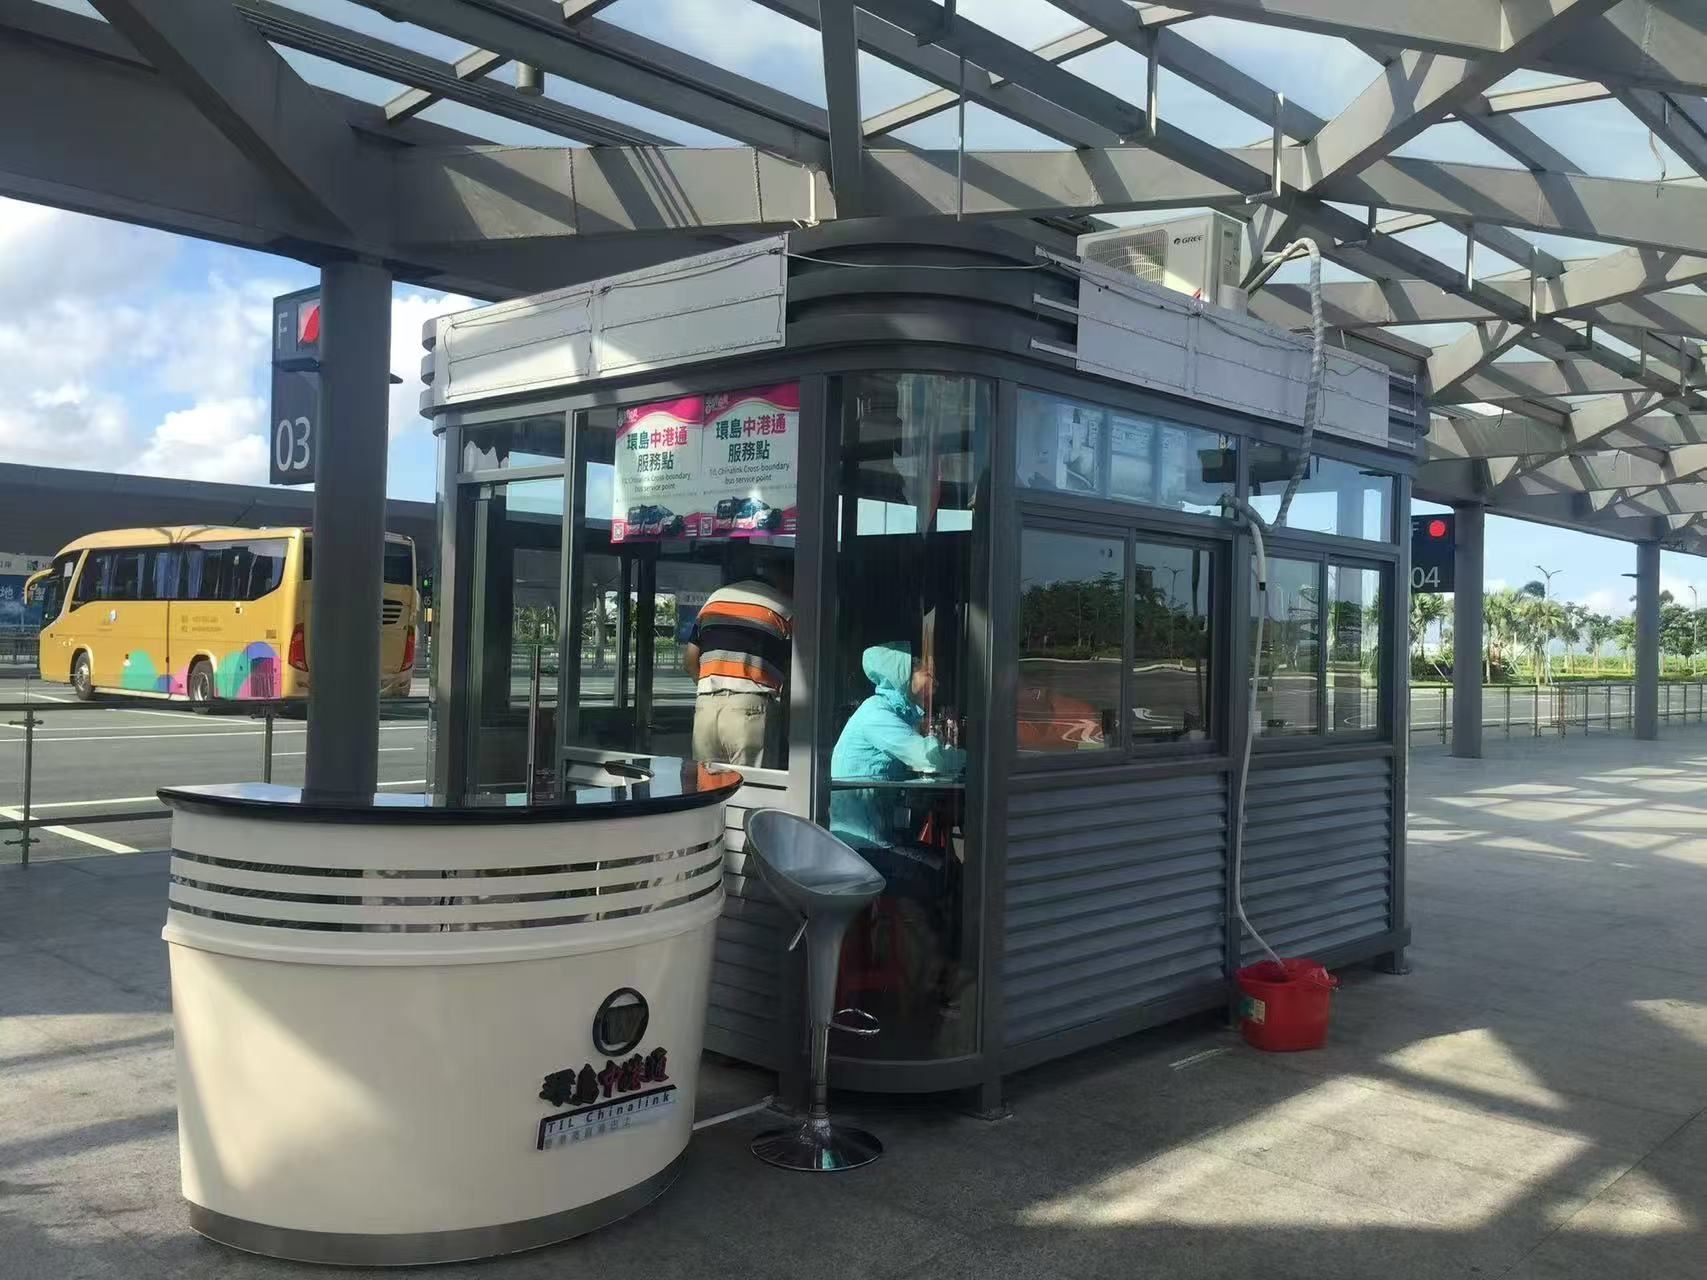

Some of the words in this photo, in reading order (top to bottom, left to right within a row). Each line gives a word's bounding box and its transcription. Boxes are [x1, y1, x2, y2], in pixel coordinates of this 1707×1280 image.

[1181, 234, 1203, 244] GREE
[277, 312, 288, 349] F
[716, 413, 786, 439] 環島中港通
[276, 416, 311, 471] 03
[626, 425, 688, 450] 環島中港通
[637, 451, 674, 472] 服務點
[728, 440, 770, 463] 服務點
[744, 462, 789, 473] Cross-boundary
[662, 483, 676, 491] point
[725, 476, 735, 485] bus
[736, 476, 755, 485] service
[756, 474, 772, 483] point
[1411, 566, 1440, 588] 04
[548, 1118, 573, 1133] TIL
[586, 1092, 669, 1122] Chinalink
